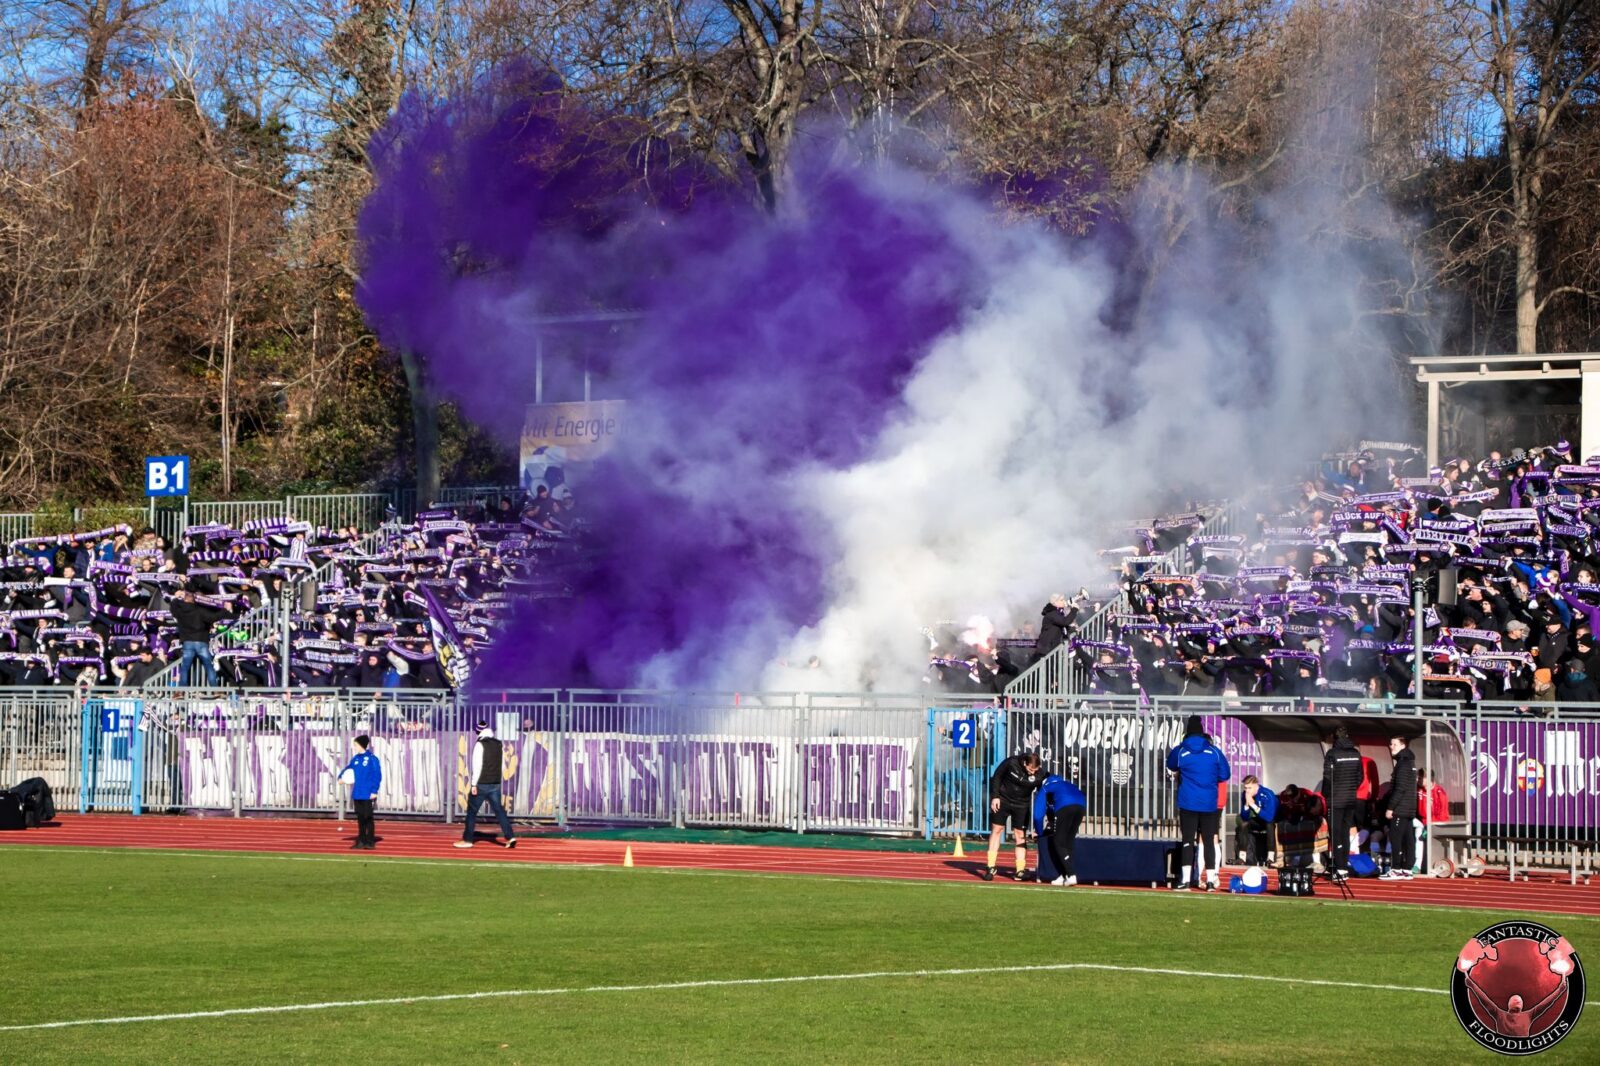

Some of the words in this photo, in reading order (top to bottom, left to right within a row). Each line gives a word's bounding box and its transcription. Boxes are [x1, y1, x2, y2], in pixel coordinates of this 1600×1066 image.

[554, 413, 616, 442] Energie
[1334, 512, 1362, 521] GLÜCK
[106, 712, 116, 731] 1
[958, 722, 970, 744] 2
